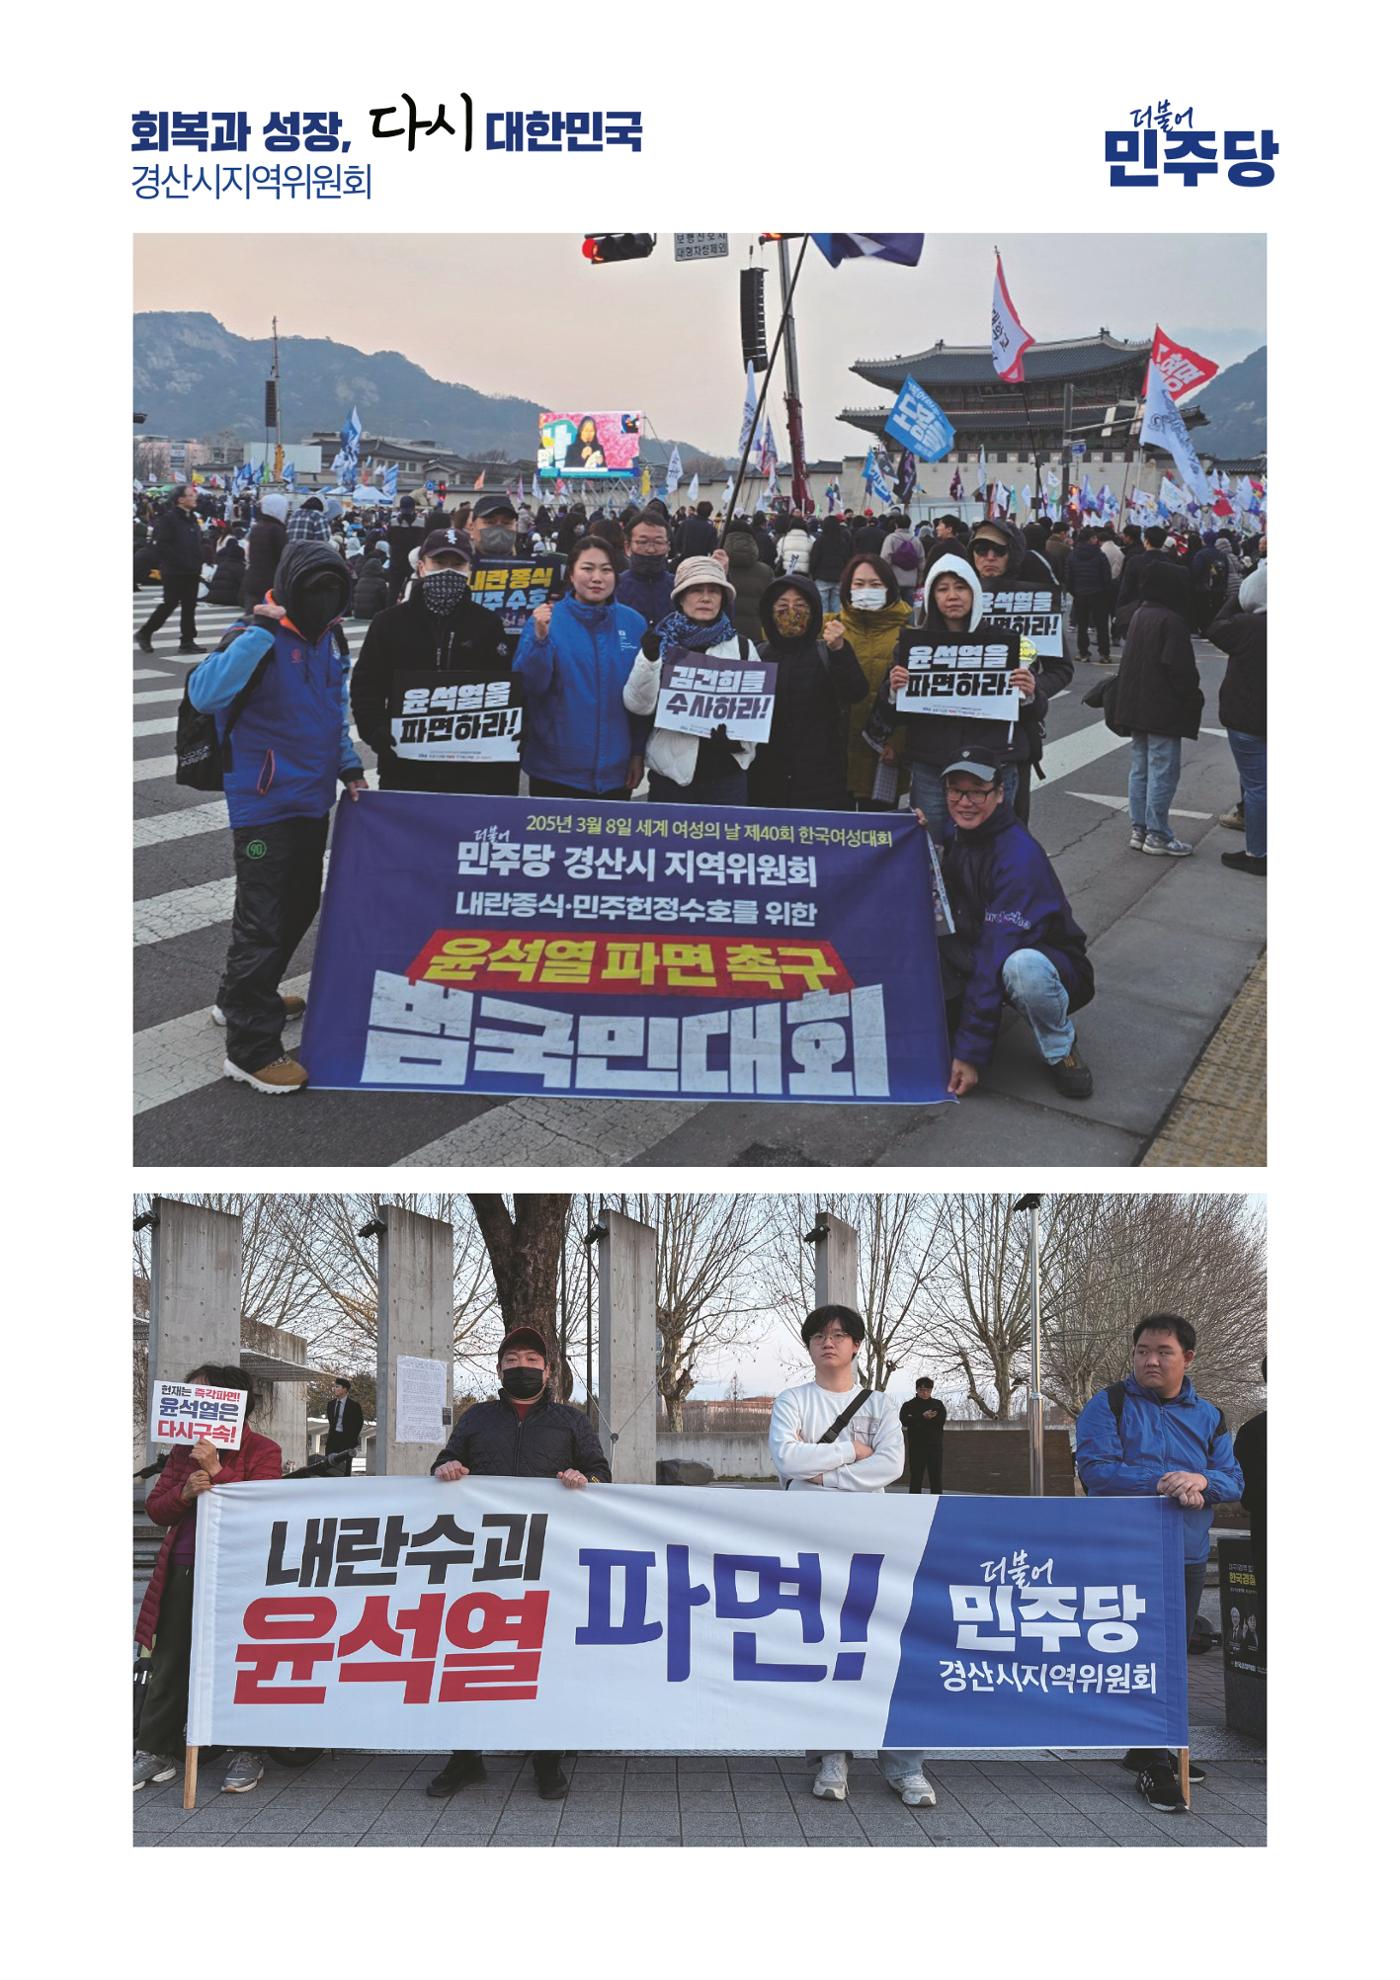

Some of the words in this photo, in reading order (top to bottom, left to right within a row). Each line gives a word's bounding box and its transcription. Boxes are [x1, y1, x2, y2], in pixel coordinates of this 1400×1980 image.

[907, 643, 1009, 670] 윤석열을
[669, 665, 766, 694] 김건희를
[402, 681, 512, 715] 윤석열을
[666, 693, 772, 720] 수사하라!
[399, 709, 520, 744] 파면하라!
[473, 825, 511, 844] 더불어
[525, 815, 572, 834] 205년
[576, 817, 602, 835] 3월
[605, 818, 631, 837] 8일
[635, 819, 669, 838] 세계
[672, 820, 720, 841] 여성의
[724, 823, 741, 841] 날
[744, 824, 795, 844] 제40회
[799, 825, 893, 848] 한국여성대회
[457, 841, 556, 878] 민주당
[563, 845, 656, 883] 경산시
[664, 849, 818, 888] 지역위원회
[764, 901, 818, 927] 위한
[423, 937, 597, 984] 윤석열
[601, 941, 718, 986] 파면
[726, 943, 836, 991] 촉구
[360, 970, 890, 1097] 범국민대회
[159, 1396, 240, 1423] 윤석열은
[194, 1387, 241, 1402] 즉각파면!
[157, 1419, 238, 1444] 다시구속!
[265, 1513, 549, 1588] 내란수괴
[979, 1548, 1054, 1589] 더불어
[575, 1543, 886, 1683] 파면!
[948, 1583, 1146, 1654] 민주당
[233, 1590, 550, 1704] 윤석열
[938, 1660, 1157, 1695] 경산시지역위원회
